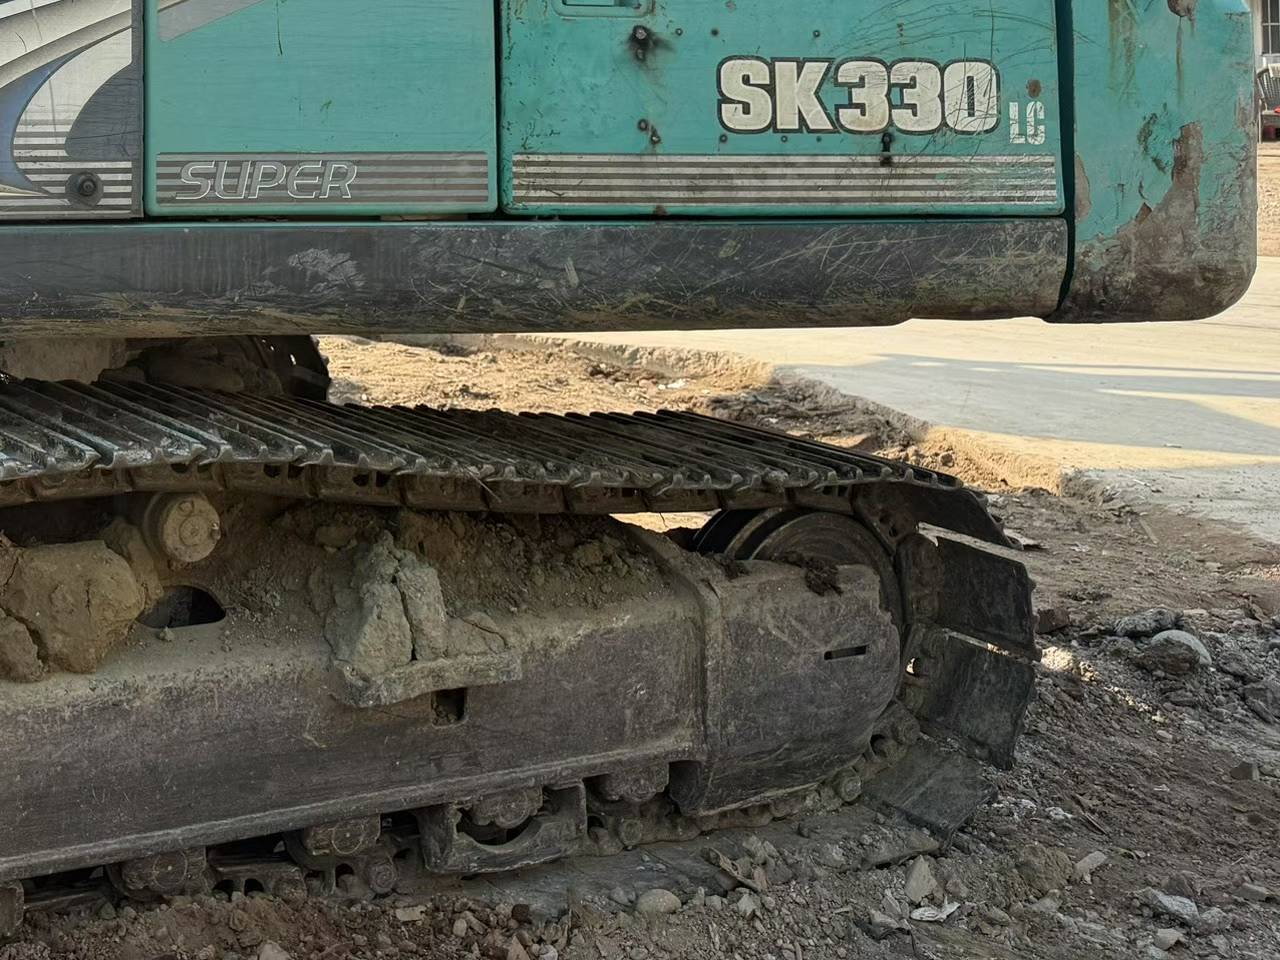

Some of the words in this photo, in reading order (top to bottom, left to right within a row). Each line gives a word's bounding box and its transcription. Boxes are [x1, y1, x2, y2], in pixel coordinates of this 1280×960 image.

[718, 55, 1000, 134] SK330
[1008, 101, 1045, 145] LC
[176, 160, 358, 200] SUPER
